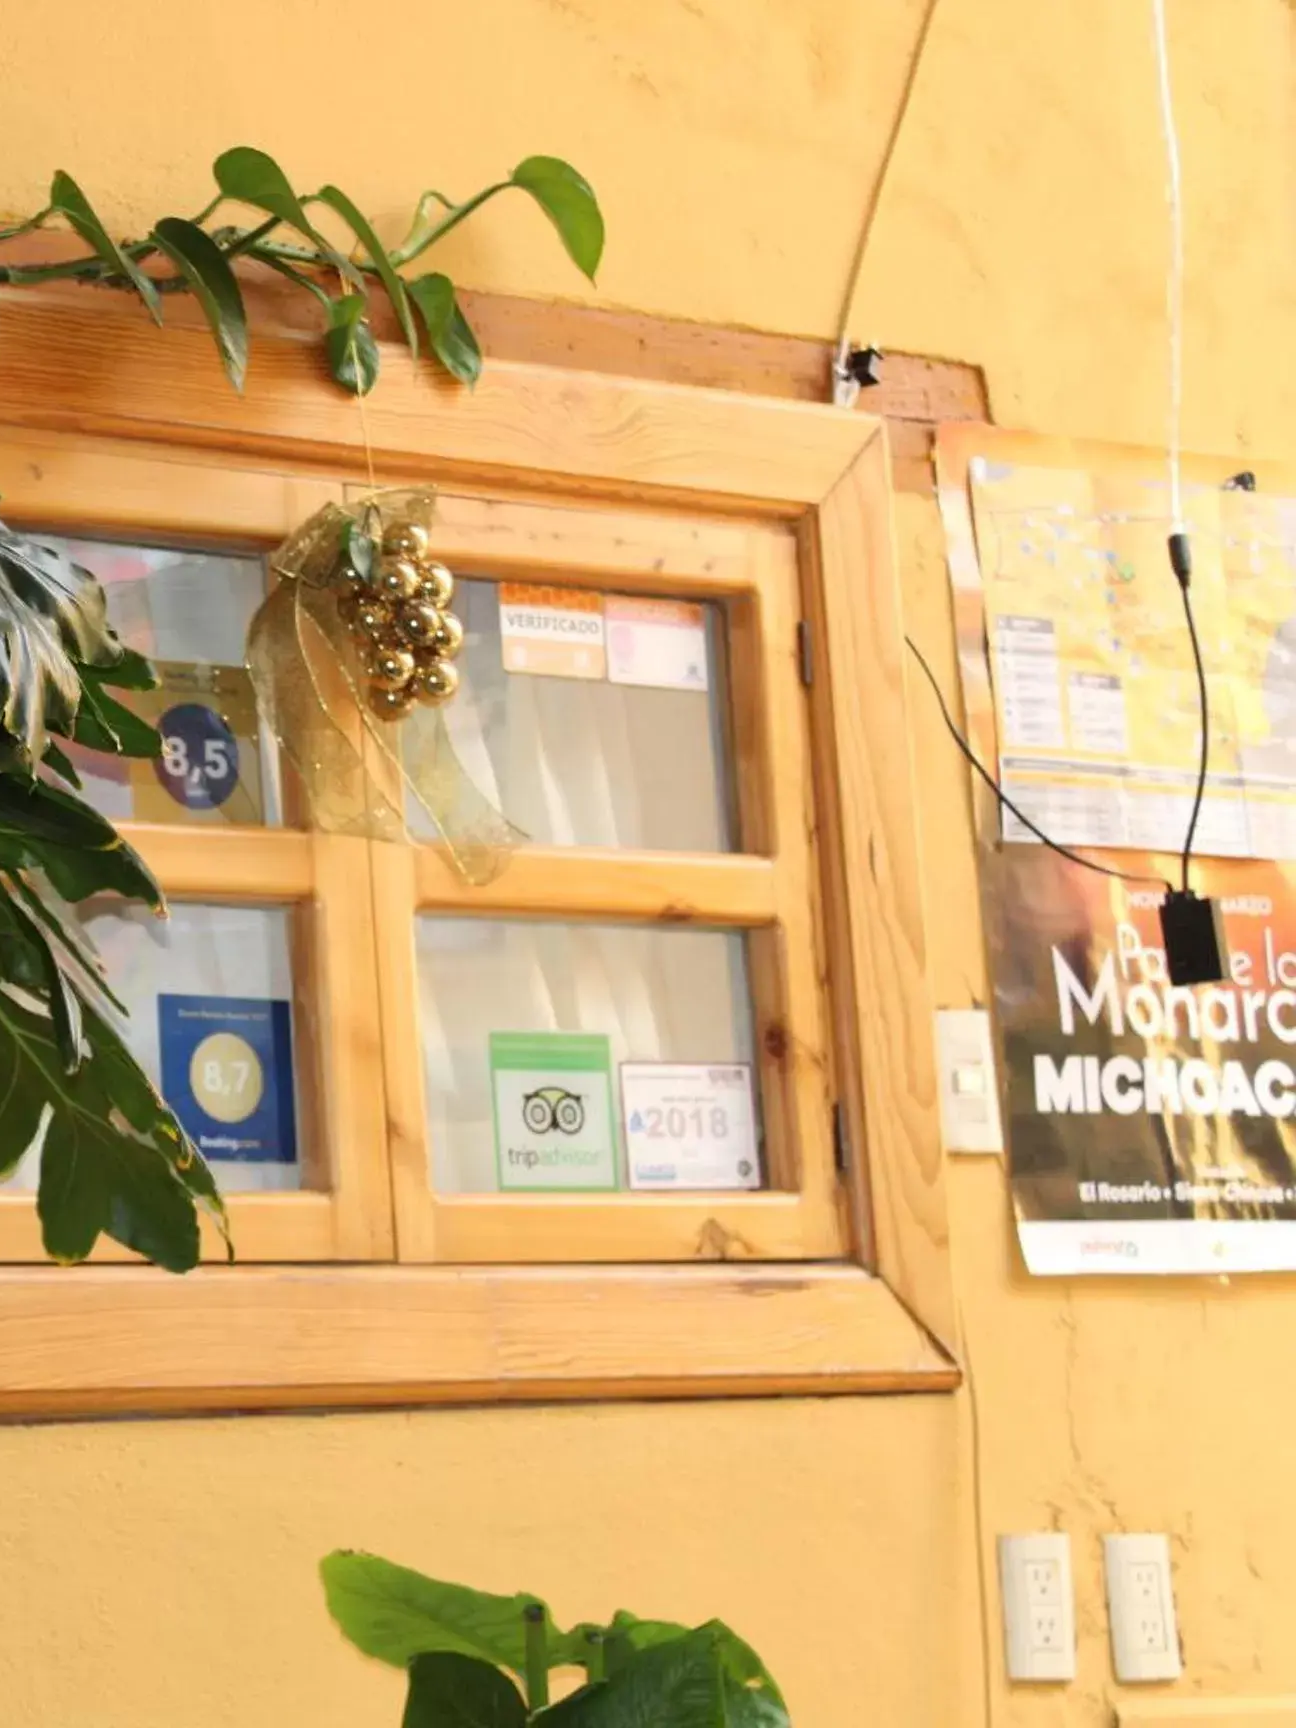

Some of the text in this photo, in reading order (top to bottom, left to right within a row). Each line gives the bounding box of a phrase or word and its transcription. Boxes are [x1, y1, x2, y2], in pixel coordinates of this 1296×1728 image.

[506, 612, 600, 635] VERIFICADO
[161, 736, 228, 783] 8,5
[204, 1061, 250, 1095] 8,7
[1032, 1054, 1296, 1117] MICHOAC
[646, 1106, 730, 1140] 2018
